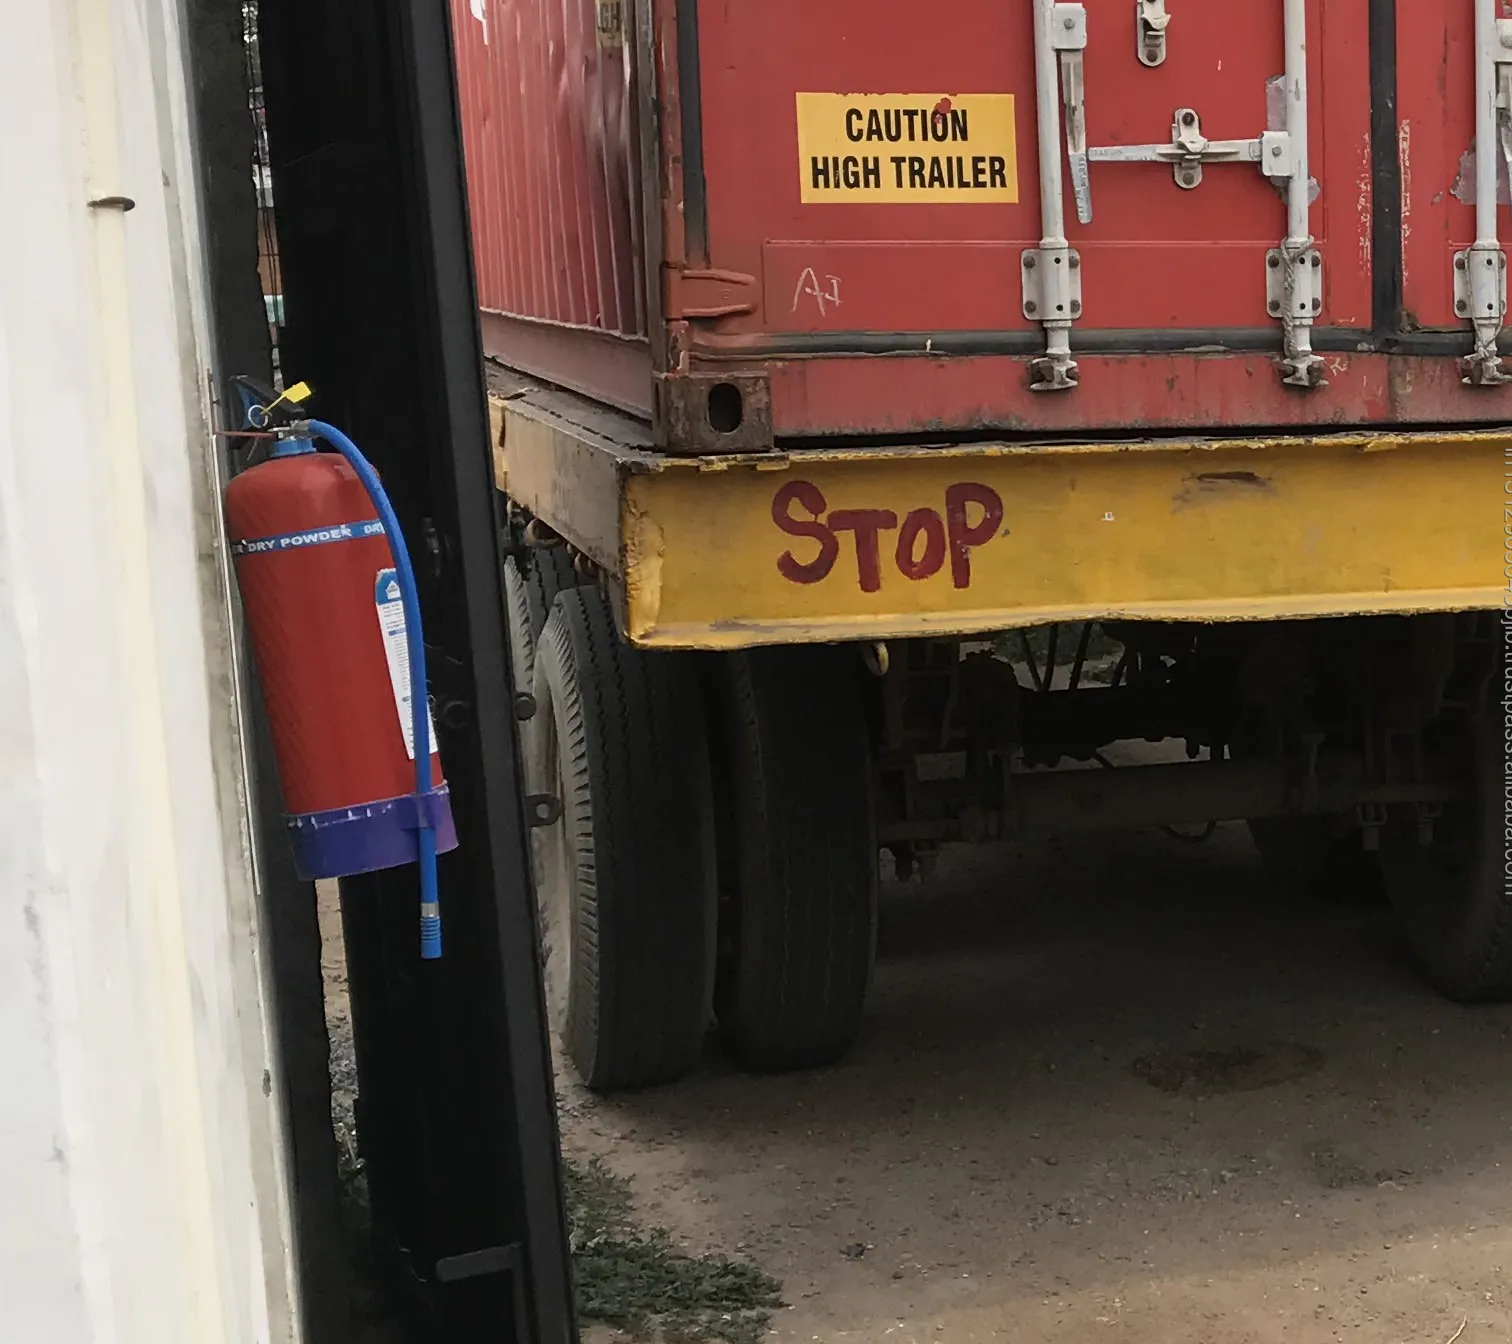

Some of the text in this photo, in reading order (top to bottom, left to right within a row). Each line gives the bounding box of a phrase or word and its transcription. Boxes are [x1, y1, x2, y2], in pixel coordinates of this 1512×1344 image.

[844, 108, 969, 143] CAUTION
[811, 156, 1008, 190] HIGH TRAILER
[248, 539, 276, 554] DRY
[280, 524, 352, 548] POWDER
[771, 480, 1004, 593] STOP
